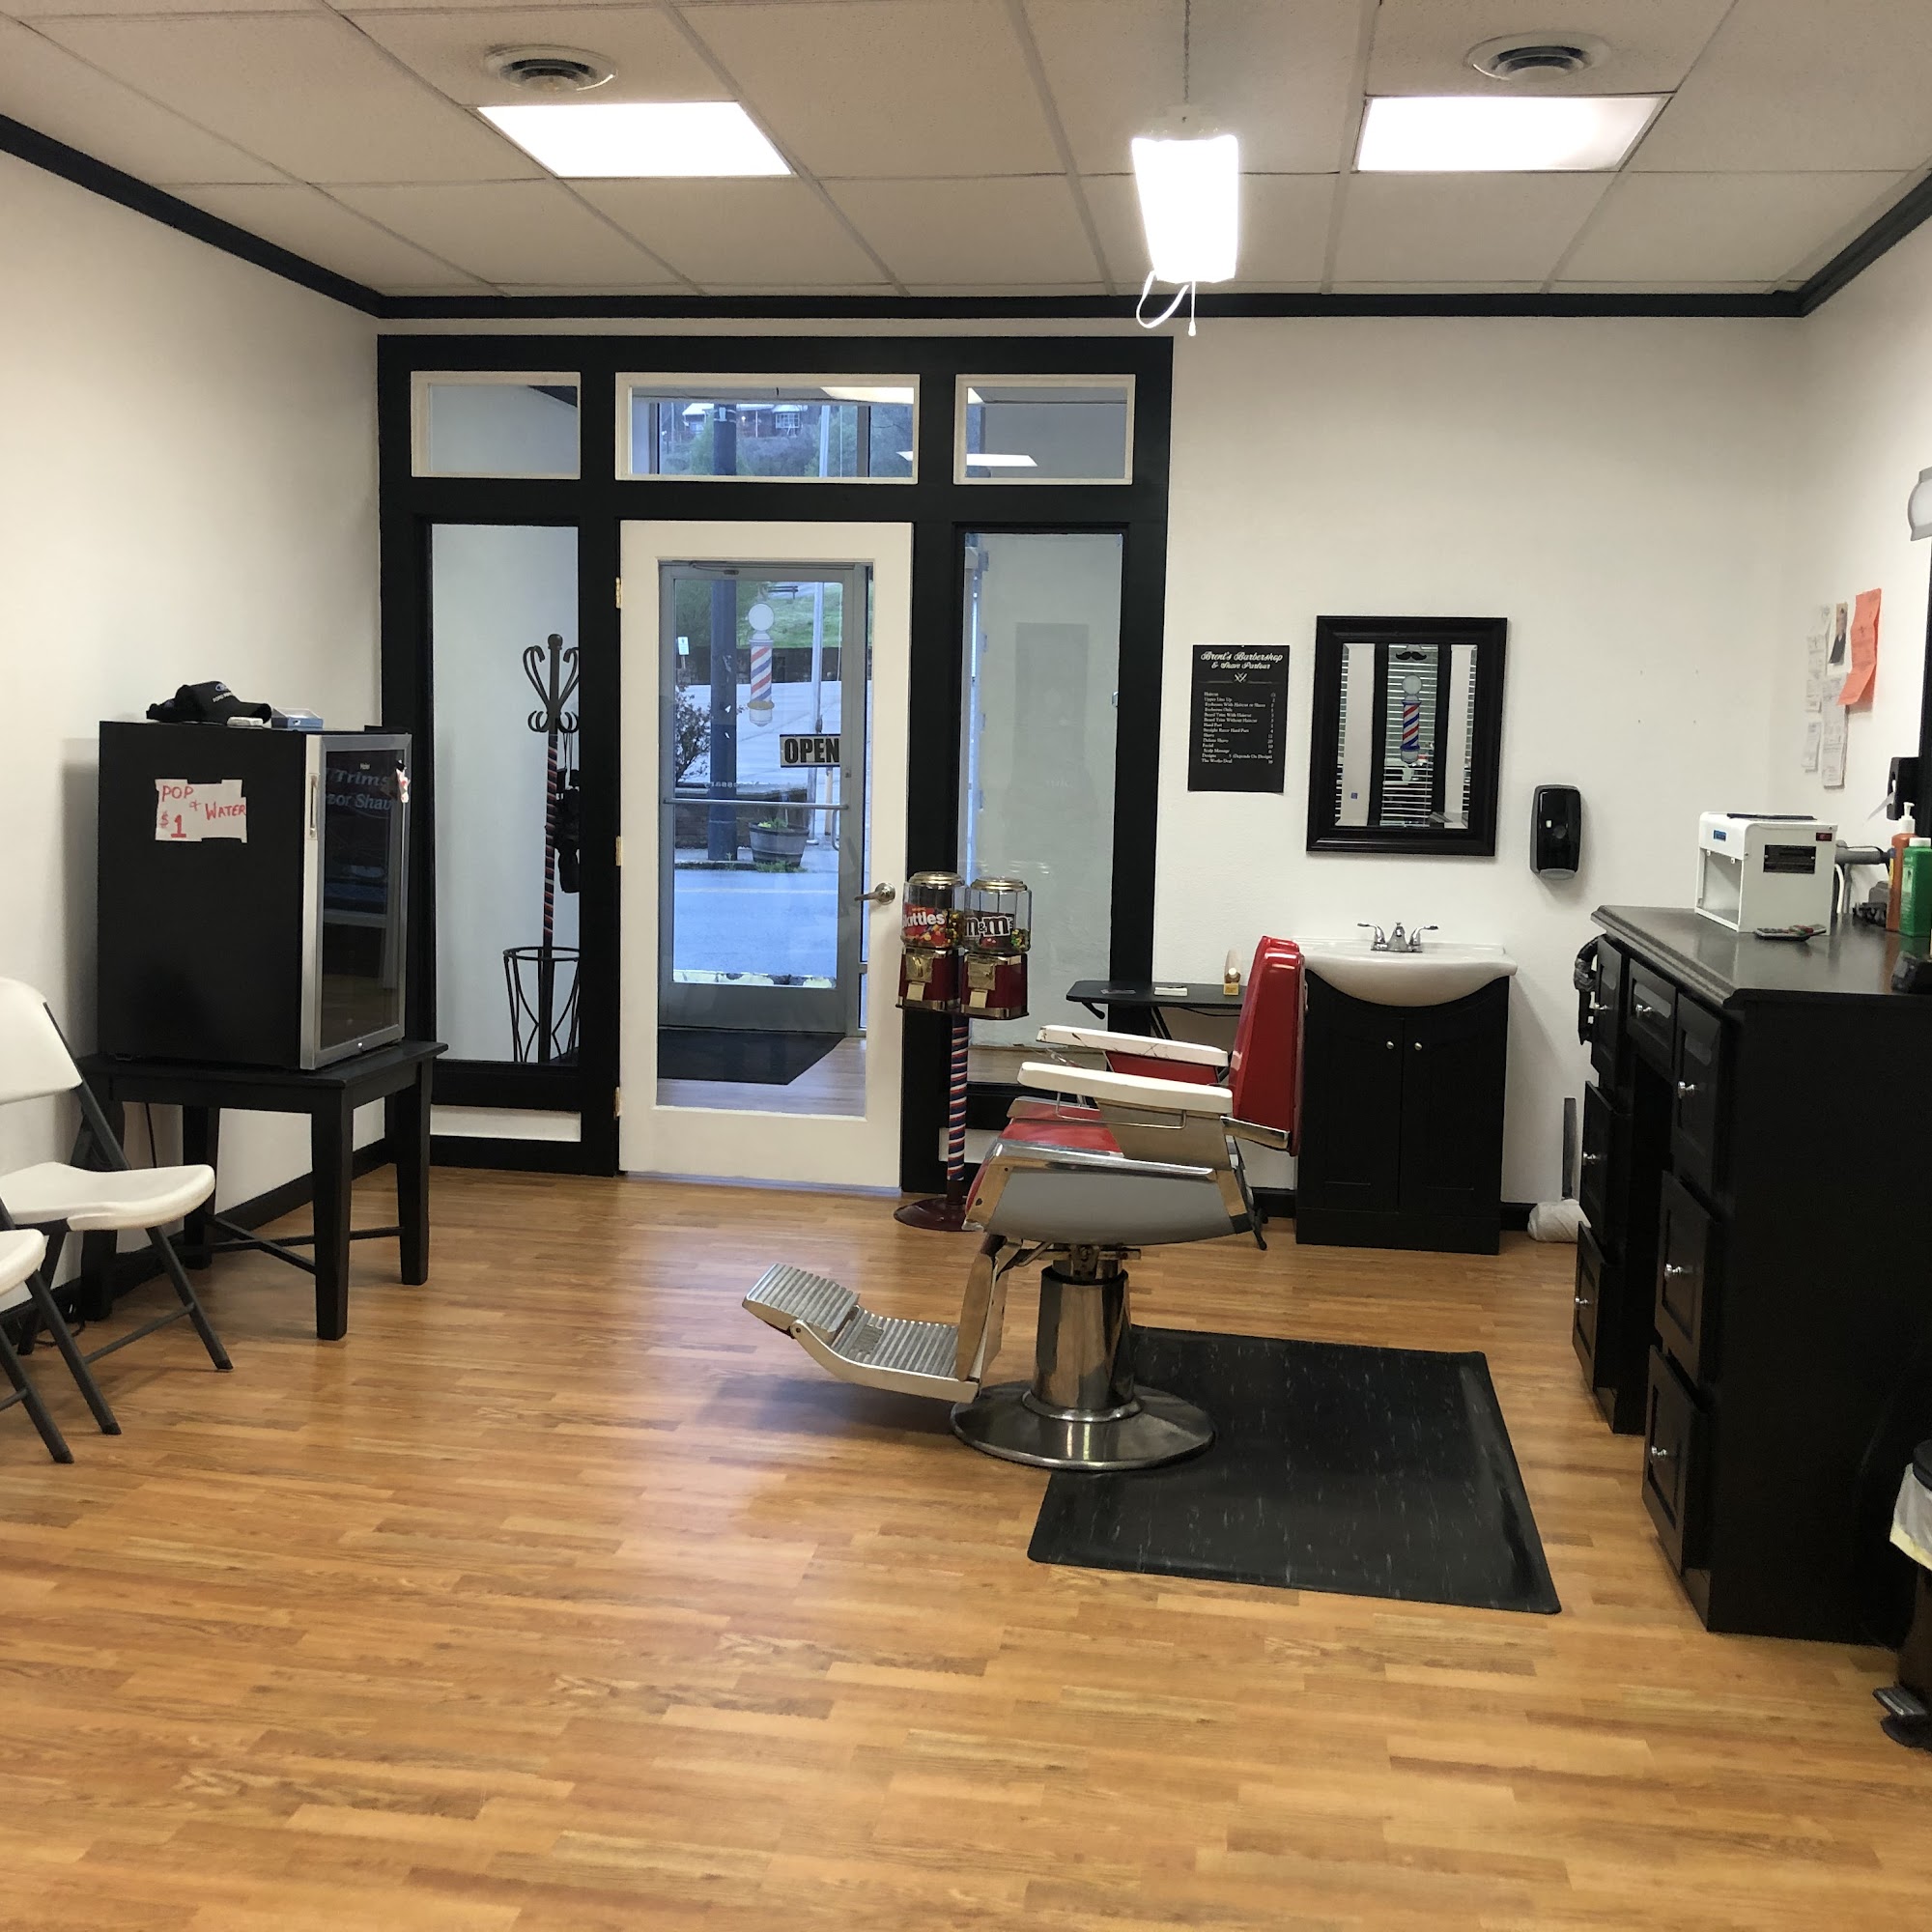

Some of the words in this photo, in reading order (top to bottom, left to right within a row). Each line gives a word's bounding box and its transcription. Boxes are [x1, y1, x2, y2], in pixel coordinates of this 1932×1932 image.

[1200, 651, 1233, 661] Brent's
[1234, 651, 1283, 663] Barbershop
[784, 738, 839, 764] OPEN
[162, 785, 194, 802] POP
[205, 801, 246, 820] WATER
[903, 912, 946, 928] kittles
